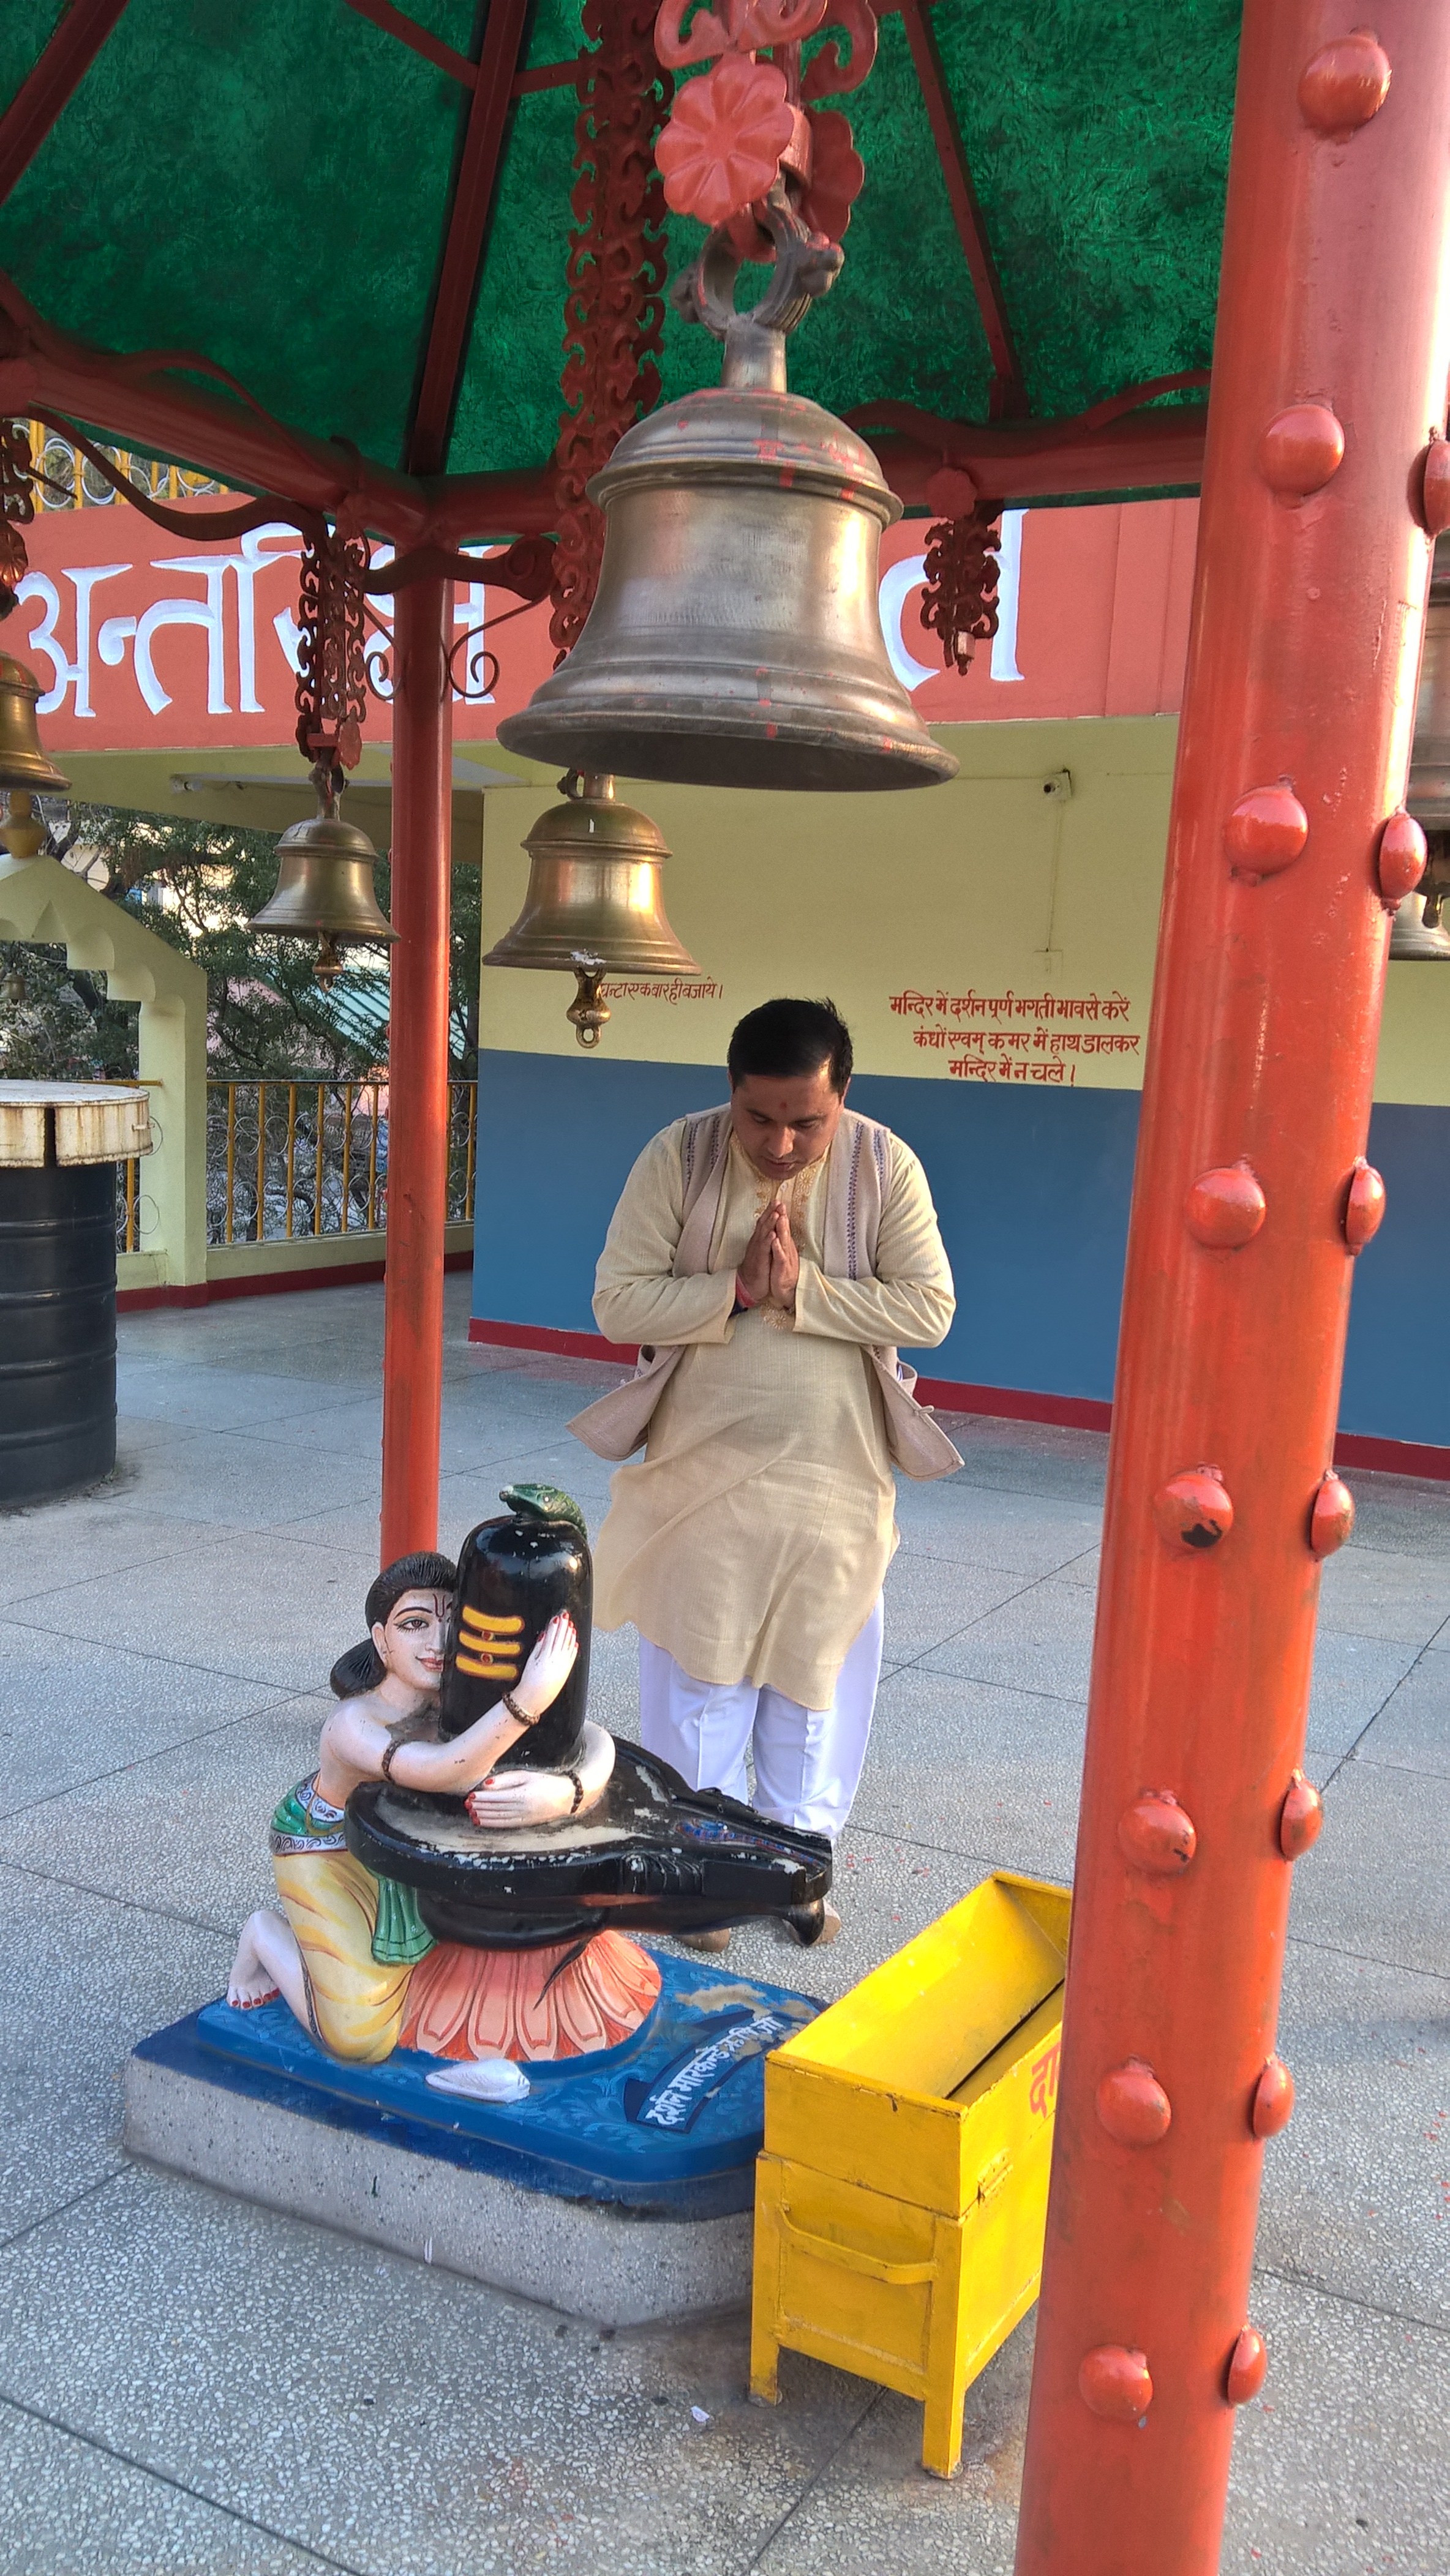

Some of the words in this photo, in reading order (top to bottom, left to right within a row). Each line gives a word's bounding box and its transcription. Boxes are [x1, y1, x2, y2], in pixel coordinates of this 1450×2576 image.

[652, 983, 669, 1002] बार
[669, 977, 683, 1005] ही
[888, 989, 934, 1019] मन्दिर
[935, 990, 949, 1016] में
[950, 989, 986, 1023] दर्शन
[1056, 999, 1086, 1019] भाव
[1086, 992, 1101, 1020] से
[1101, 990, 1131, 1022] करें
[913, 1024, 947, 1049] कंधों
[987, 1032, 1031, 1053] कमर
[1032, 1026, 1048, 1051] में
[1050, 1034, 1082, 1055] हाथ
[1081, 1034, 1141, 1056] डालकर
[948, 1054, 997, 1082] मन्दिर
[998, 1053, 1013, 1080] में
[1013, 1061, 1029, 1081] न
[645, 2089, 692, 2125] दर्शन
